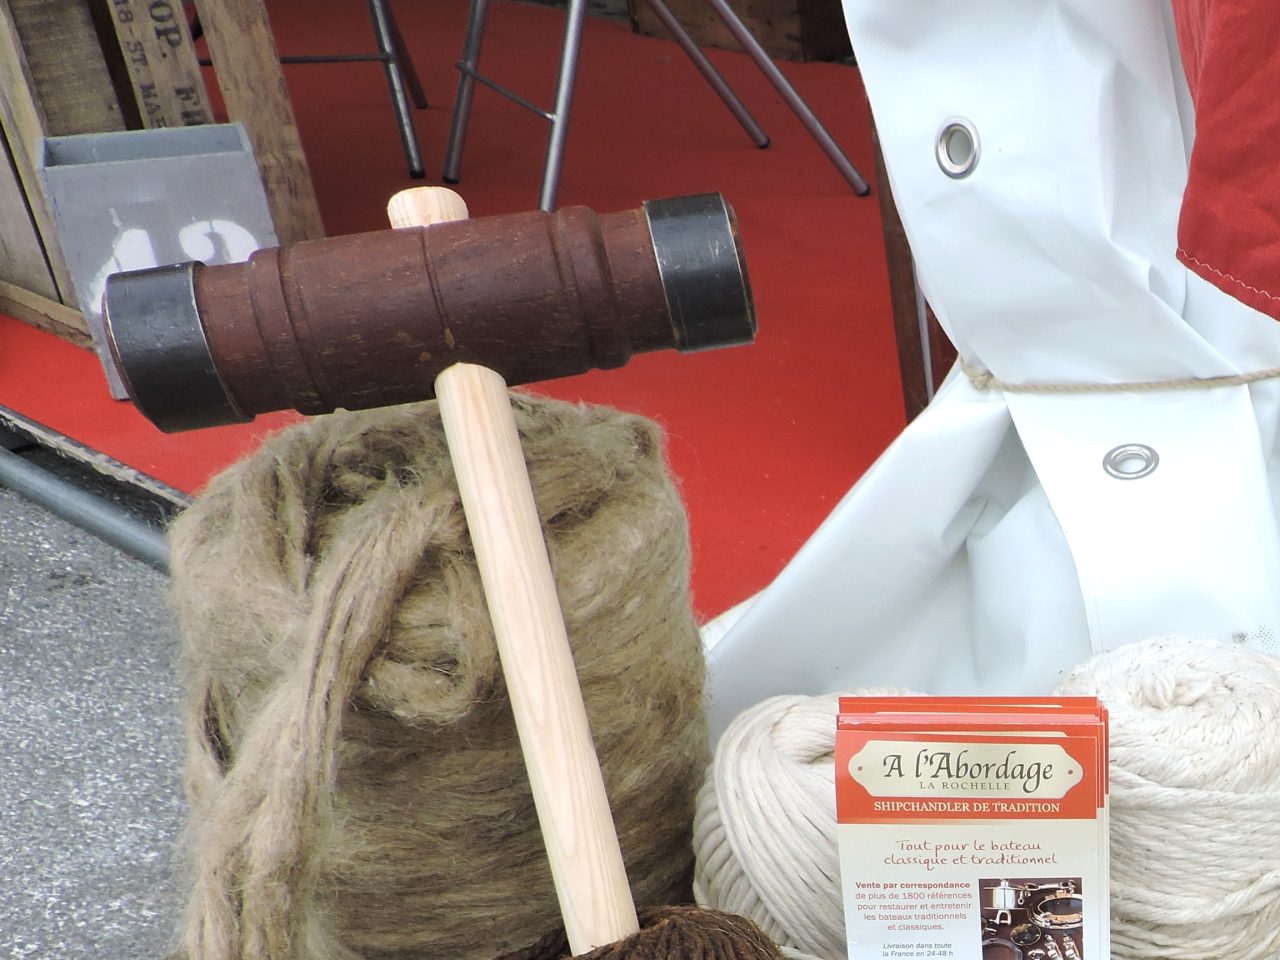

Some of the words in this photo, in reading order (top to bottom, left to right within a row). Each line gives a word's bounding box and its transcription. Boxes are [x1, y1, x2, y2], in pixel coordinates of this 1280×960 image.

[882, 754, 905, 778] A
[915, 748, 1054, 794] l'Abordage
[920, 781, 936, 790] LA
[942, 781, 1011, 791] ROCHELLE
[873, 801, 970, 813] SHIPCHANDLER
[972, 802, 991, 813] DE
[991, 801, 1061, 814] TRADITION
[896, 840, 931, 852] Tout
[935, 842, 970, 858] pour
[973, 839, 986, 851] le
[991, 839, 1042, 851] bateau
[883, 853, 948, 871] classique
[952, 854, 969, 865] et
[970, 852, 1060, 865] traditionnel
[855, 881, 881, 889] Vente
[900, 881, 971, 890] correspondance
[855, 892, 866, 900] de
[868, 892, 886, 900] plus
[888, 892, 900, 900] de
[902, 892, 925, 900] 1800
[927, 891, 973, 900] références
[879, 903, 918, 911] restaurer
[930, 902, 972, 910] entretenir
[864, 913, 876, 921] les
[878, 913, 912, 921] bateaux
[914, 912, 967, 921] traditionnels
[898, 923, 945, 932] classiques.
